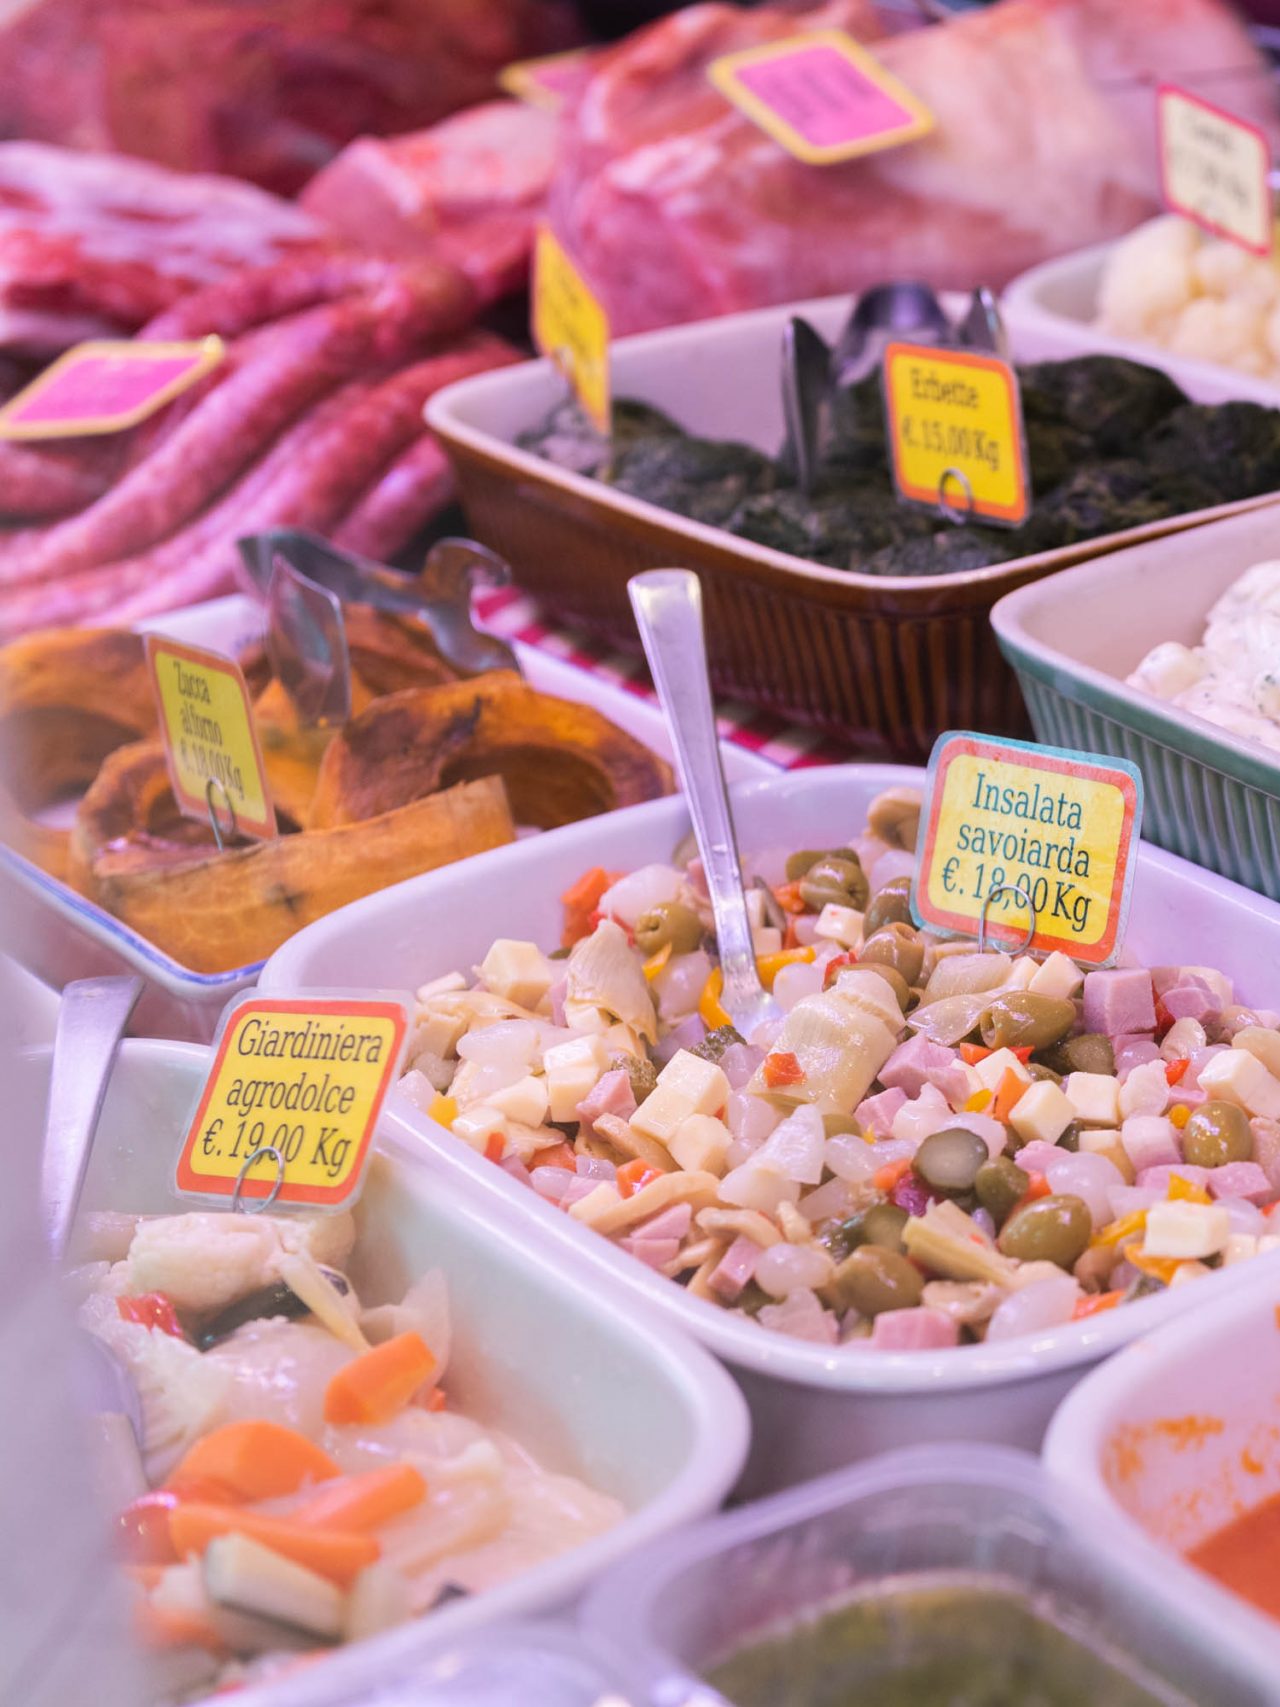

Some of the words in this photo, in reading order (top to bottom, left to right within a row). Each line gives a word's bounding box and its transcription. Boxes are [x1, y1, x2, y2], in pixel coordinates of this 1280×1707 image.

[911, 368, 978, 409] Erbette
[173, 661, 211, 704] Zucca
[973, 773, 1082, 830] Insalata
[957, 824, 1090, 878] savoiarda
[238, 1019, 383, 1063] Giardiniera
[227, 1072, 355, 1116] agrodolce
[310, 1128, 352, 1177] Kg
